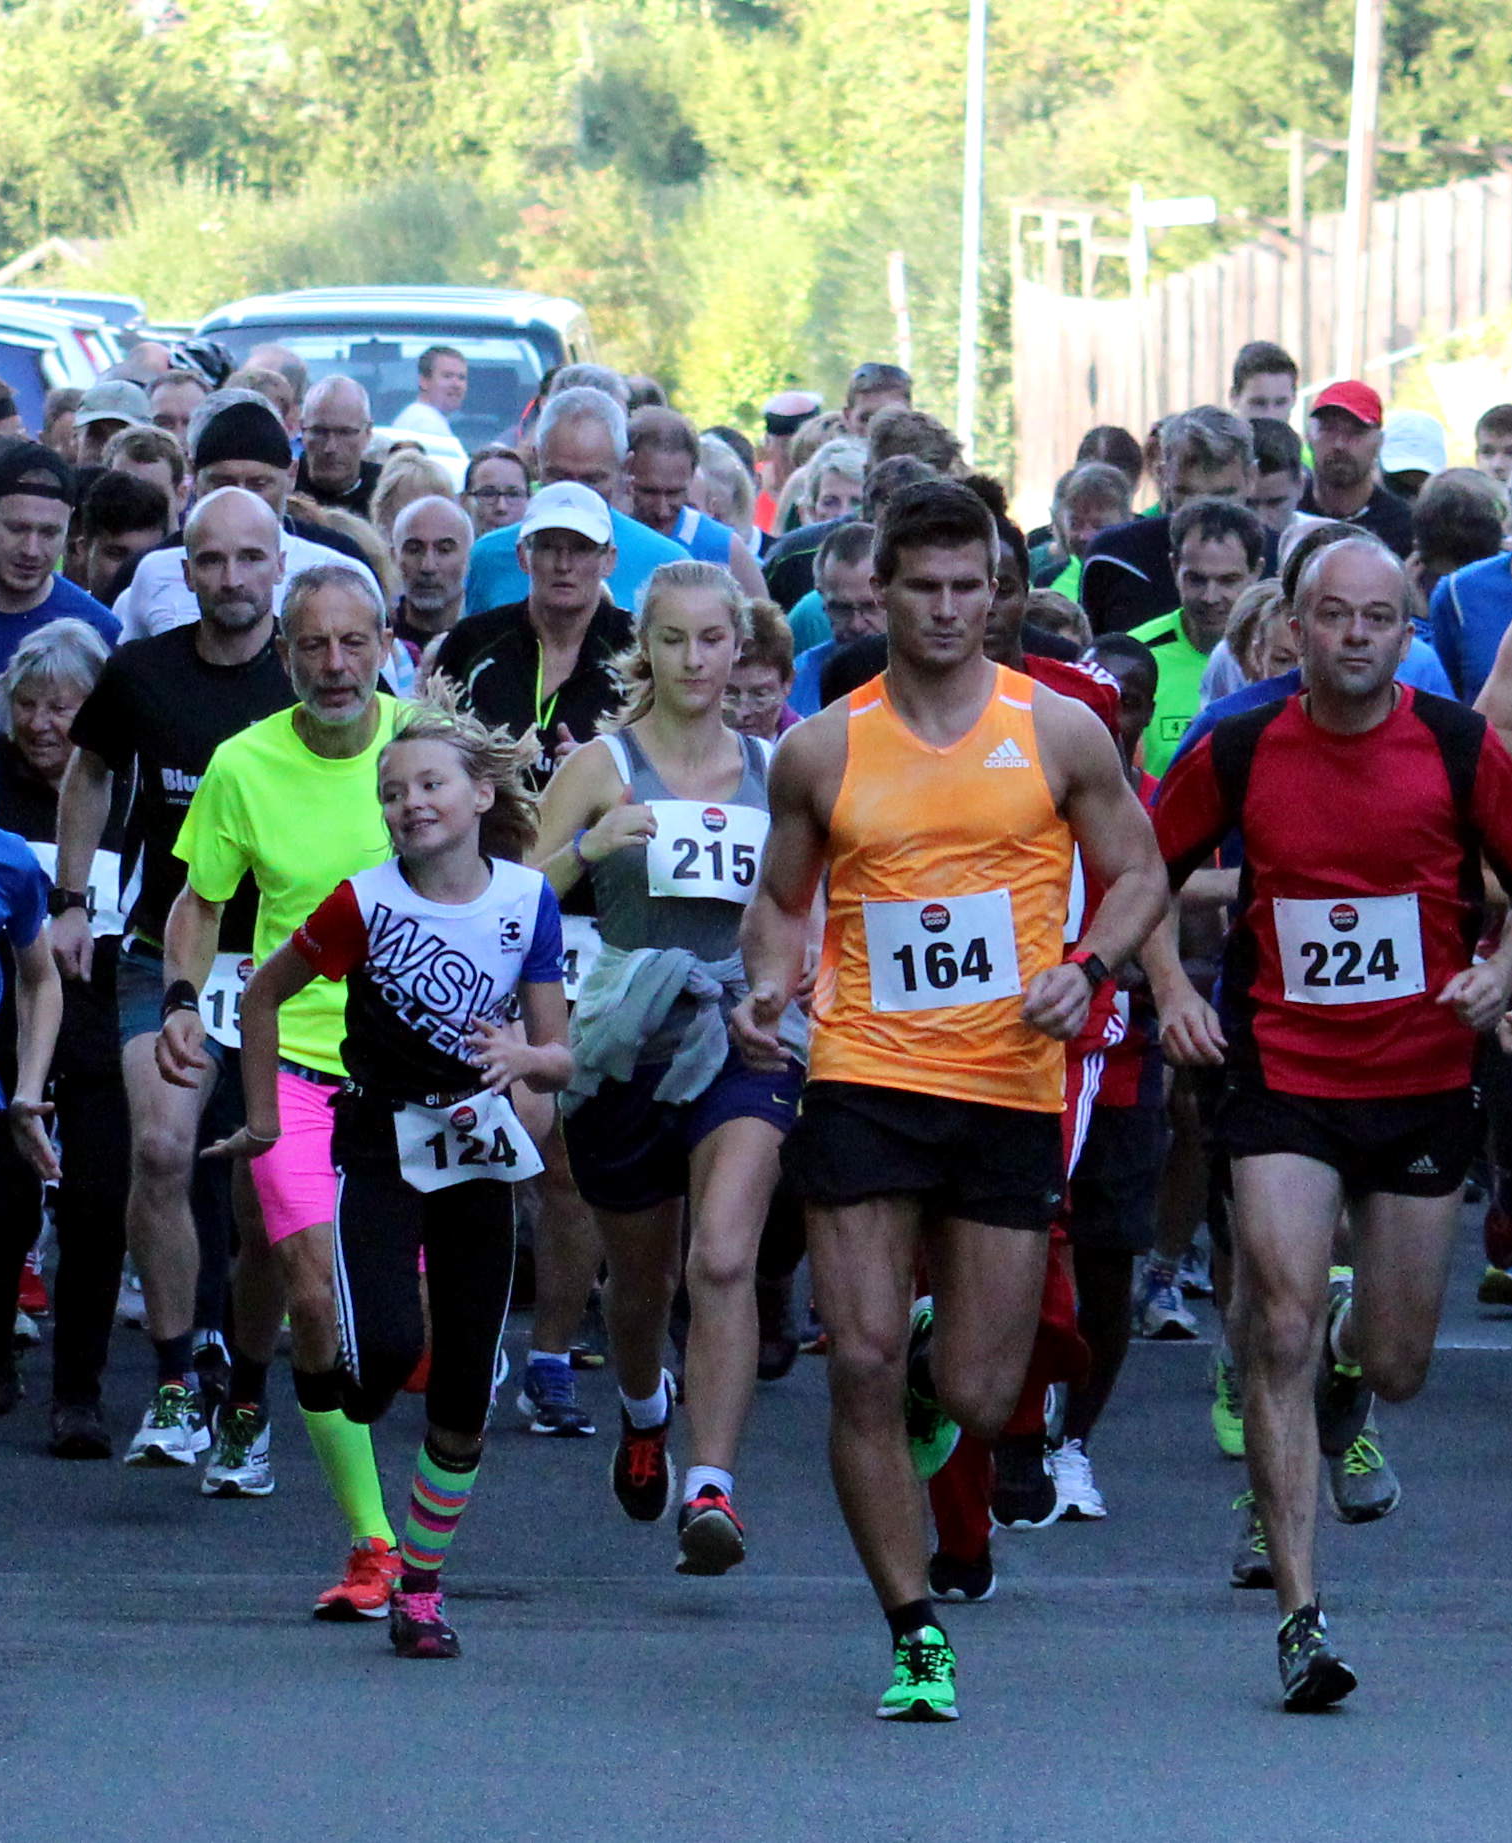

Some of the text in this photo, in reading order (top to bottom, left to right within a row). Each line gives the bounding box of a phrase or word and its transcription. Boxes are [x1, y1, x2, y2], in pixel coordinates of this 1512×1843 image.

[982, 757, 1031, 769] adidas
[672, 838, 756, 887] 215
[922, 911, 948, 920] SPORT
[924, 917, 947, 926] 2000
[893, 937, 993, 992] 164
[1301, 938, 1399, 987] 224
[425, 1127, 518, 1170] 124
